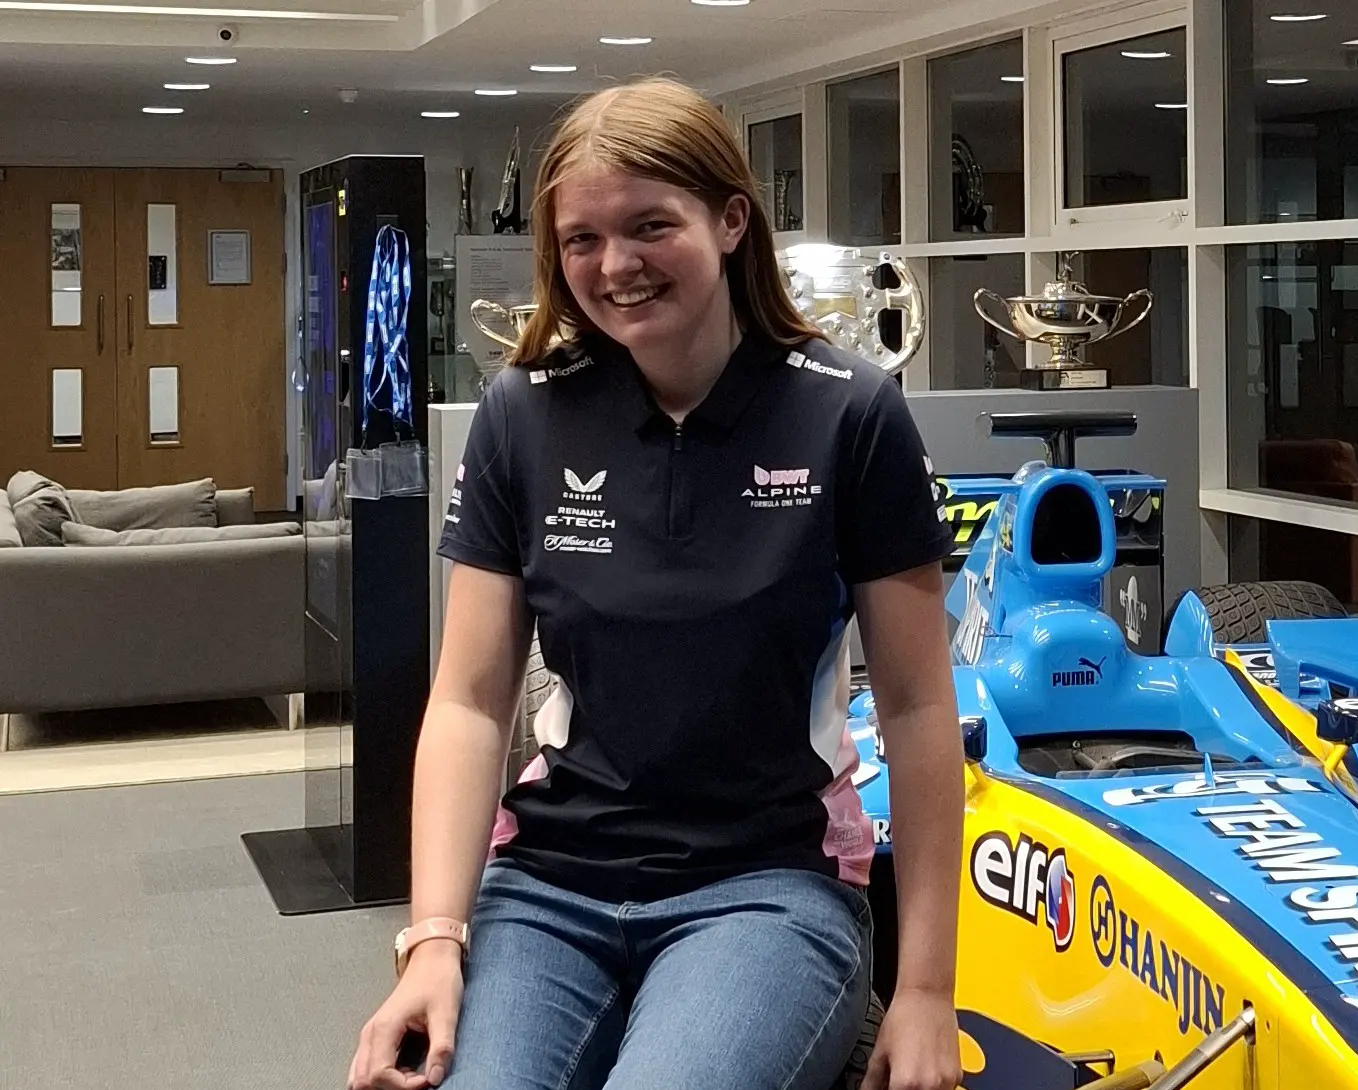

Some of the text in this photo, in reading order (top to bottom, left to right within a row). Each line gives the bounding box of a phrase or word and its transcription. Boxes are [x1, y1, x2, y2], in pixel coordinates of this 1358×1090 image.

[548, 356, 594, 378] Microsoft
[804, 359, 853, 380] Microsoft
[741, 486, 822, 497] ALPINE
[558, 506, 605, 517] RENAULT
[750, 500, 780, 508] FORMULA
[781, 499, 793, 507] ONE
[545, 515, 616, 528] E-TECH
[1052, 670, 1095, 687] PUMA
[974, 838, 1047, 918] elf
[1119, 908, 1226, 1036] HANJIN
